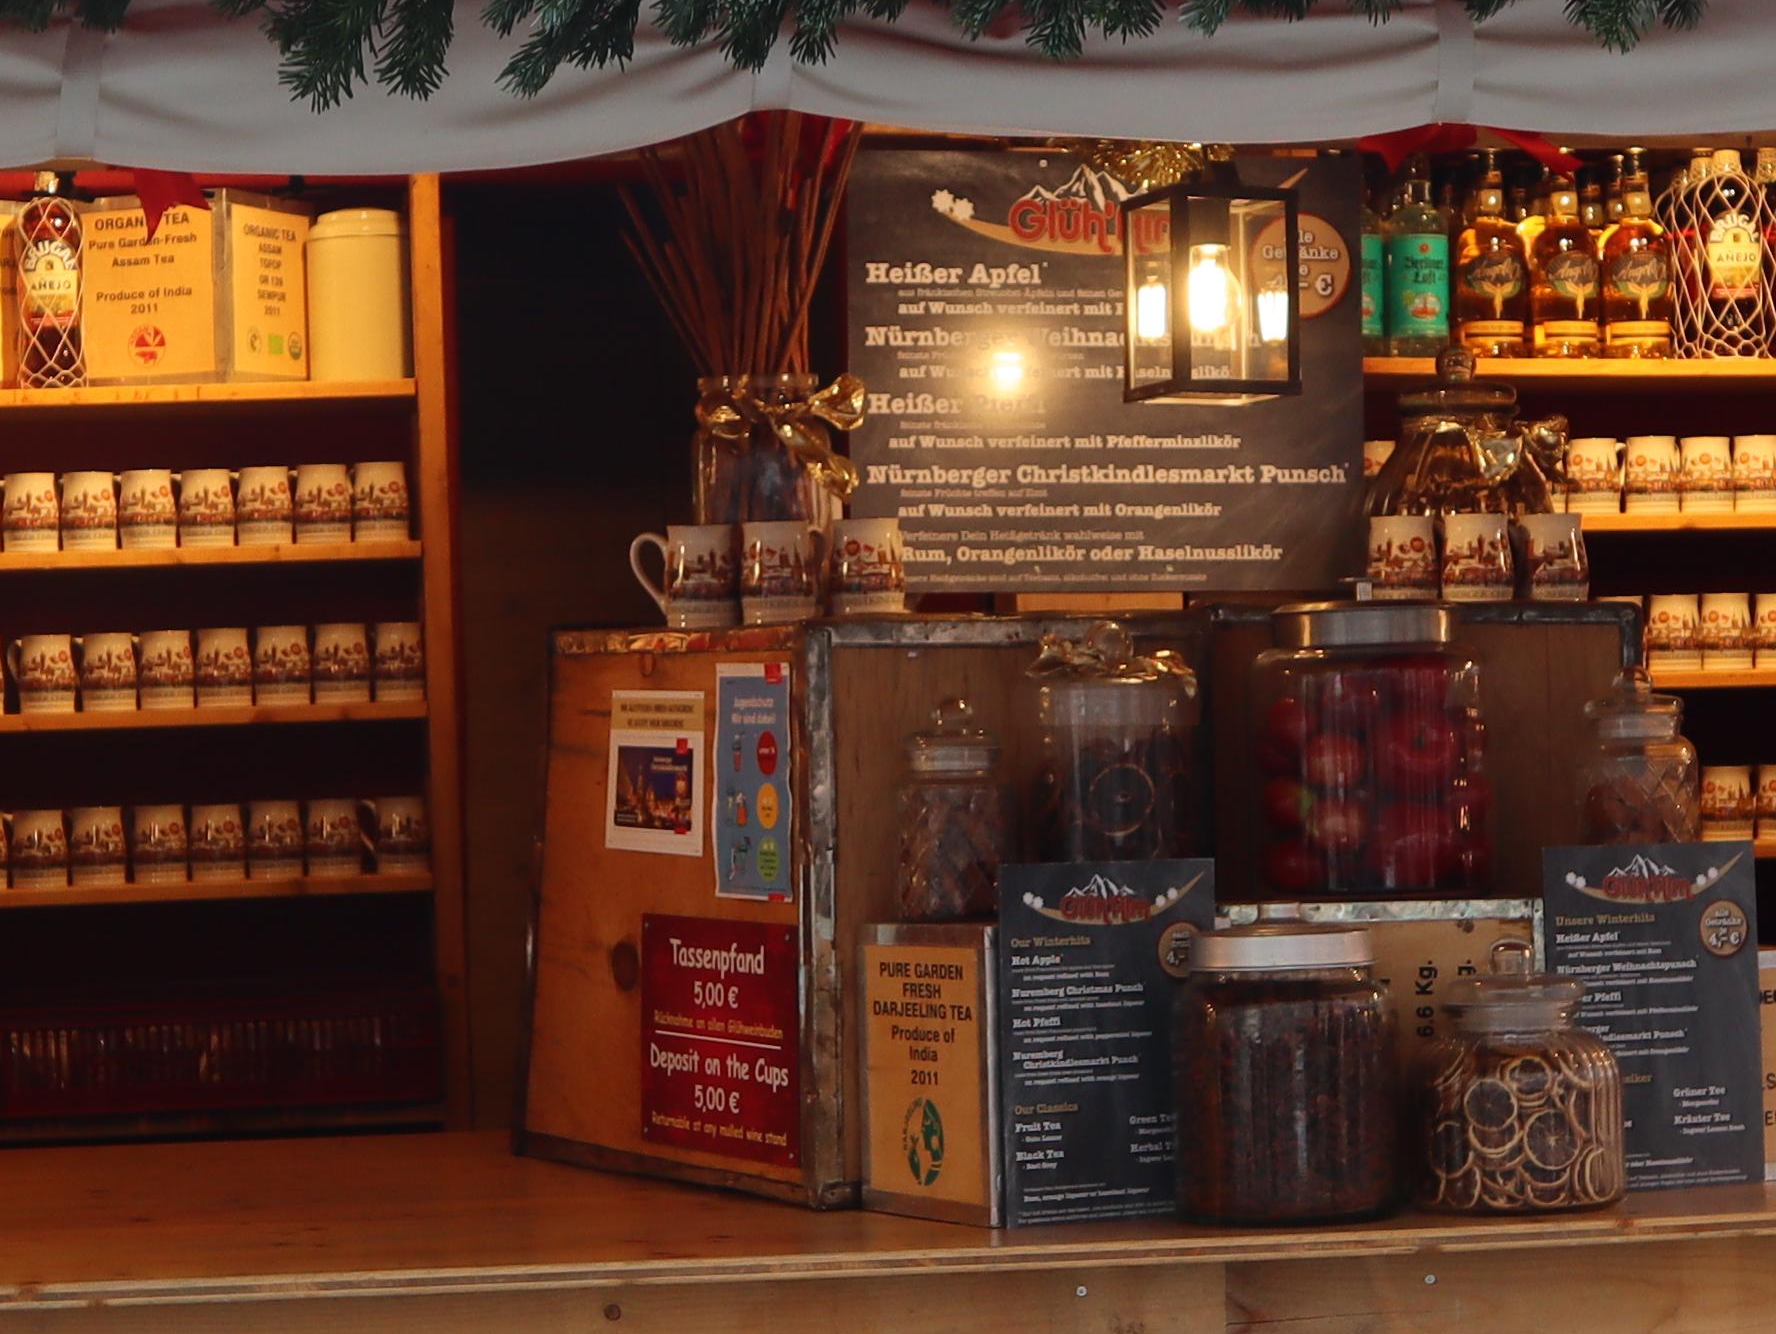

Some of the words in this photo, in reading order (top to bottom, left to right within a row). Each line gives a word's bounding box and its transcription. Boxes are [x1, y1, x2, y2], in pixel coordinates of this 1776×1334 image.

[95, 215, 144, 231] ORGAN
[164, 212, 190, 226] TEA
[89, 239, 115, 250] Pure
[281, 229, 296, 242] TEA
[112, 256, 150, 267] Assam
[154, 254, 174, 265] Tea
[865, 262, 963, 283] Heißer
[96, 289, 144, 301] Produce
[148, 288, 161, 298] of
[164, 286, 192, 297] India
[131, 303, 158, 314] 2011
[867, 464, 1011, 487] Nürnberger
[1017, 464, 1255, 484] Christkindlesmarkt
[669, 938, 764, 979] Tassenpfand
[880, 962, 910, 977] PURE
[914, 963, 963, 980] GARDEN
[1415, 960, 1438, 995] Kg.
[694, 981, 723, 1009] 5,00
[728, 986, 739, 1008] €
[903, 982, 941, 999] FRESH
[874, 1001, 946, 1019] DARJEELING
[950, 1005, 972, 1021] TEA
[892, 1025, 939, 1043] Produce
[943, 1027, 955, 1043] of
[909, 1046, 938, 1062] India
[650, 1043, 699, 1076] Deposit
[705, 1054, 720, 1077] on
[726, 1053, 749, 1080] the
[755, 1058, 788, 1093] Cups
[911, 1070, 938, 1085] 2011
[694, 1084, 724, 1113] 5,00
[729, 1091, 740, 1114] €
